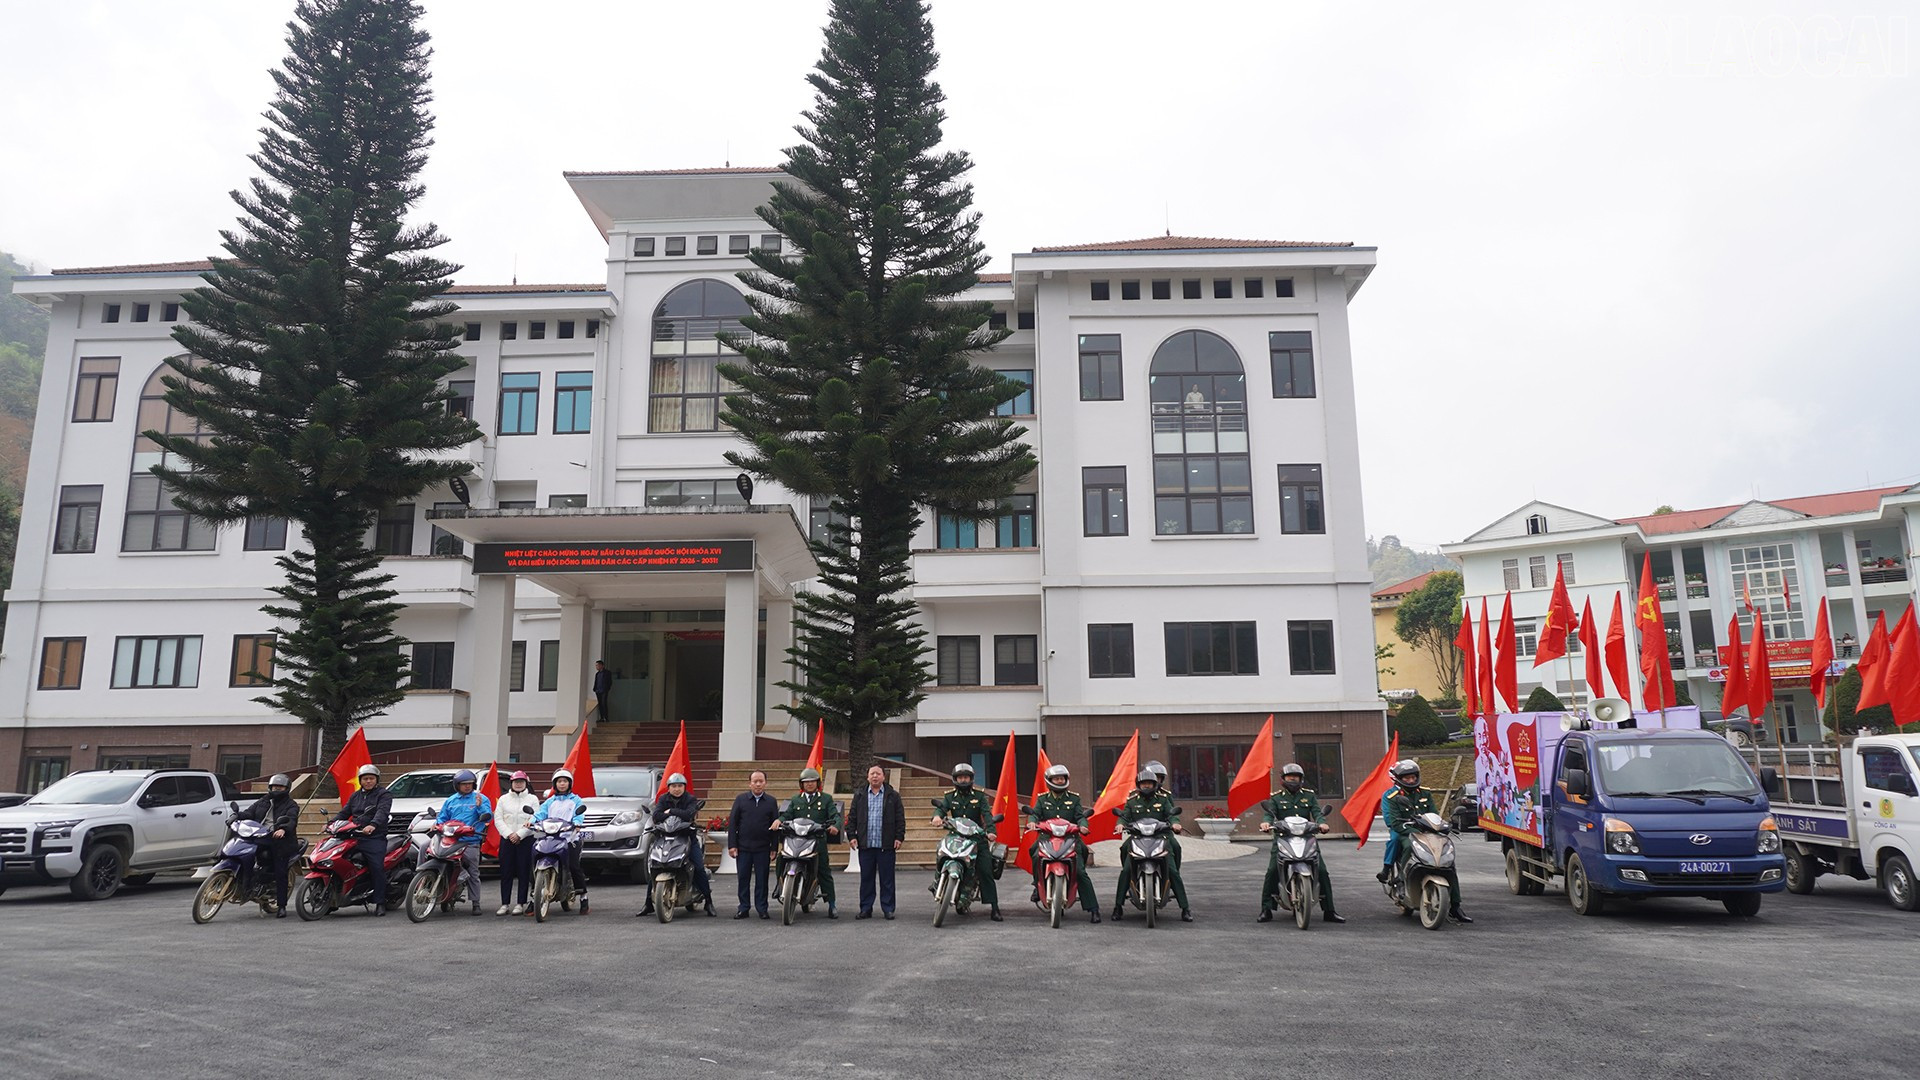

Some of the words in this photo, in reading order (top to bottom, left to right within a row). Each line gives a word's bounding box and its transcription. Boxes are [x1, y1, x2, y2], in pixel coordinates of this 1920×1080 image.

[1776, 814, 1794, 829] ẢNH
[1798, 818, 1817, 832] SÁT
[1873, 821, 1888, 829] CÔNG
